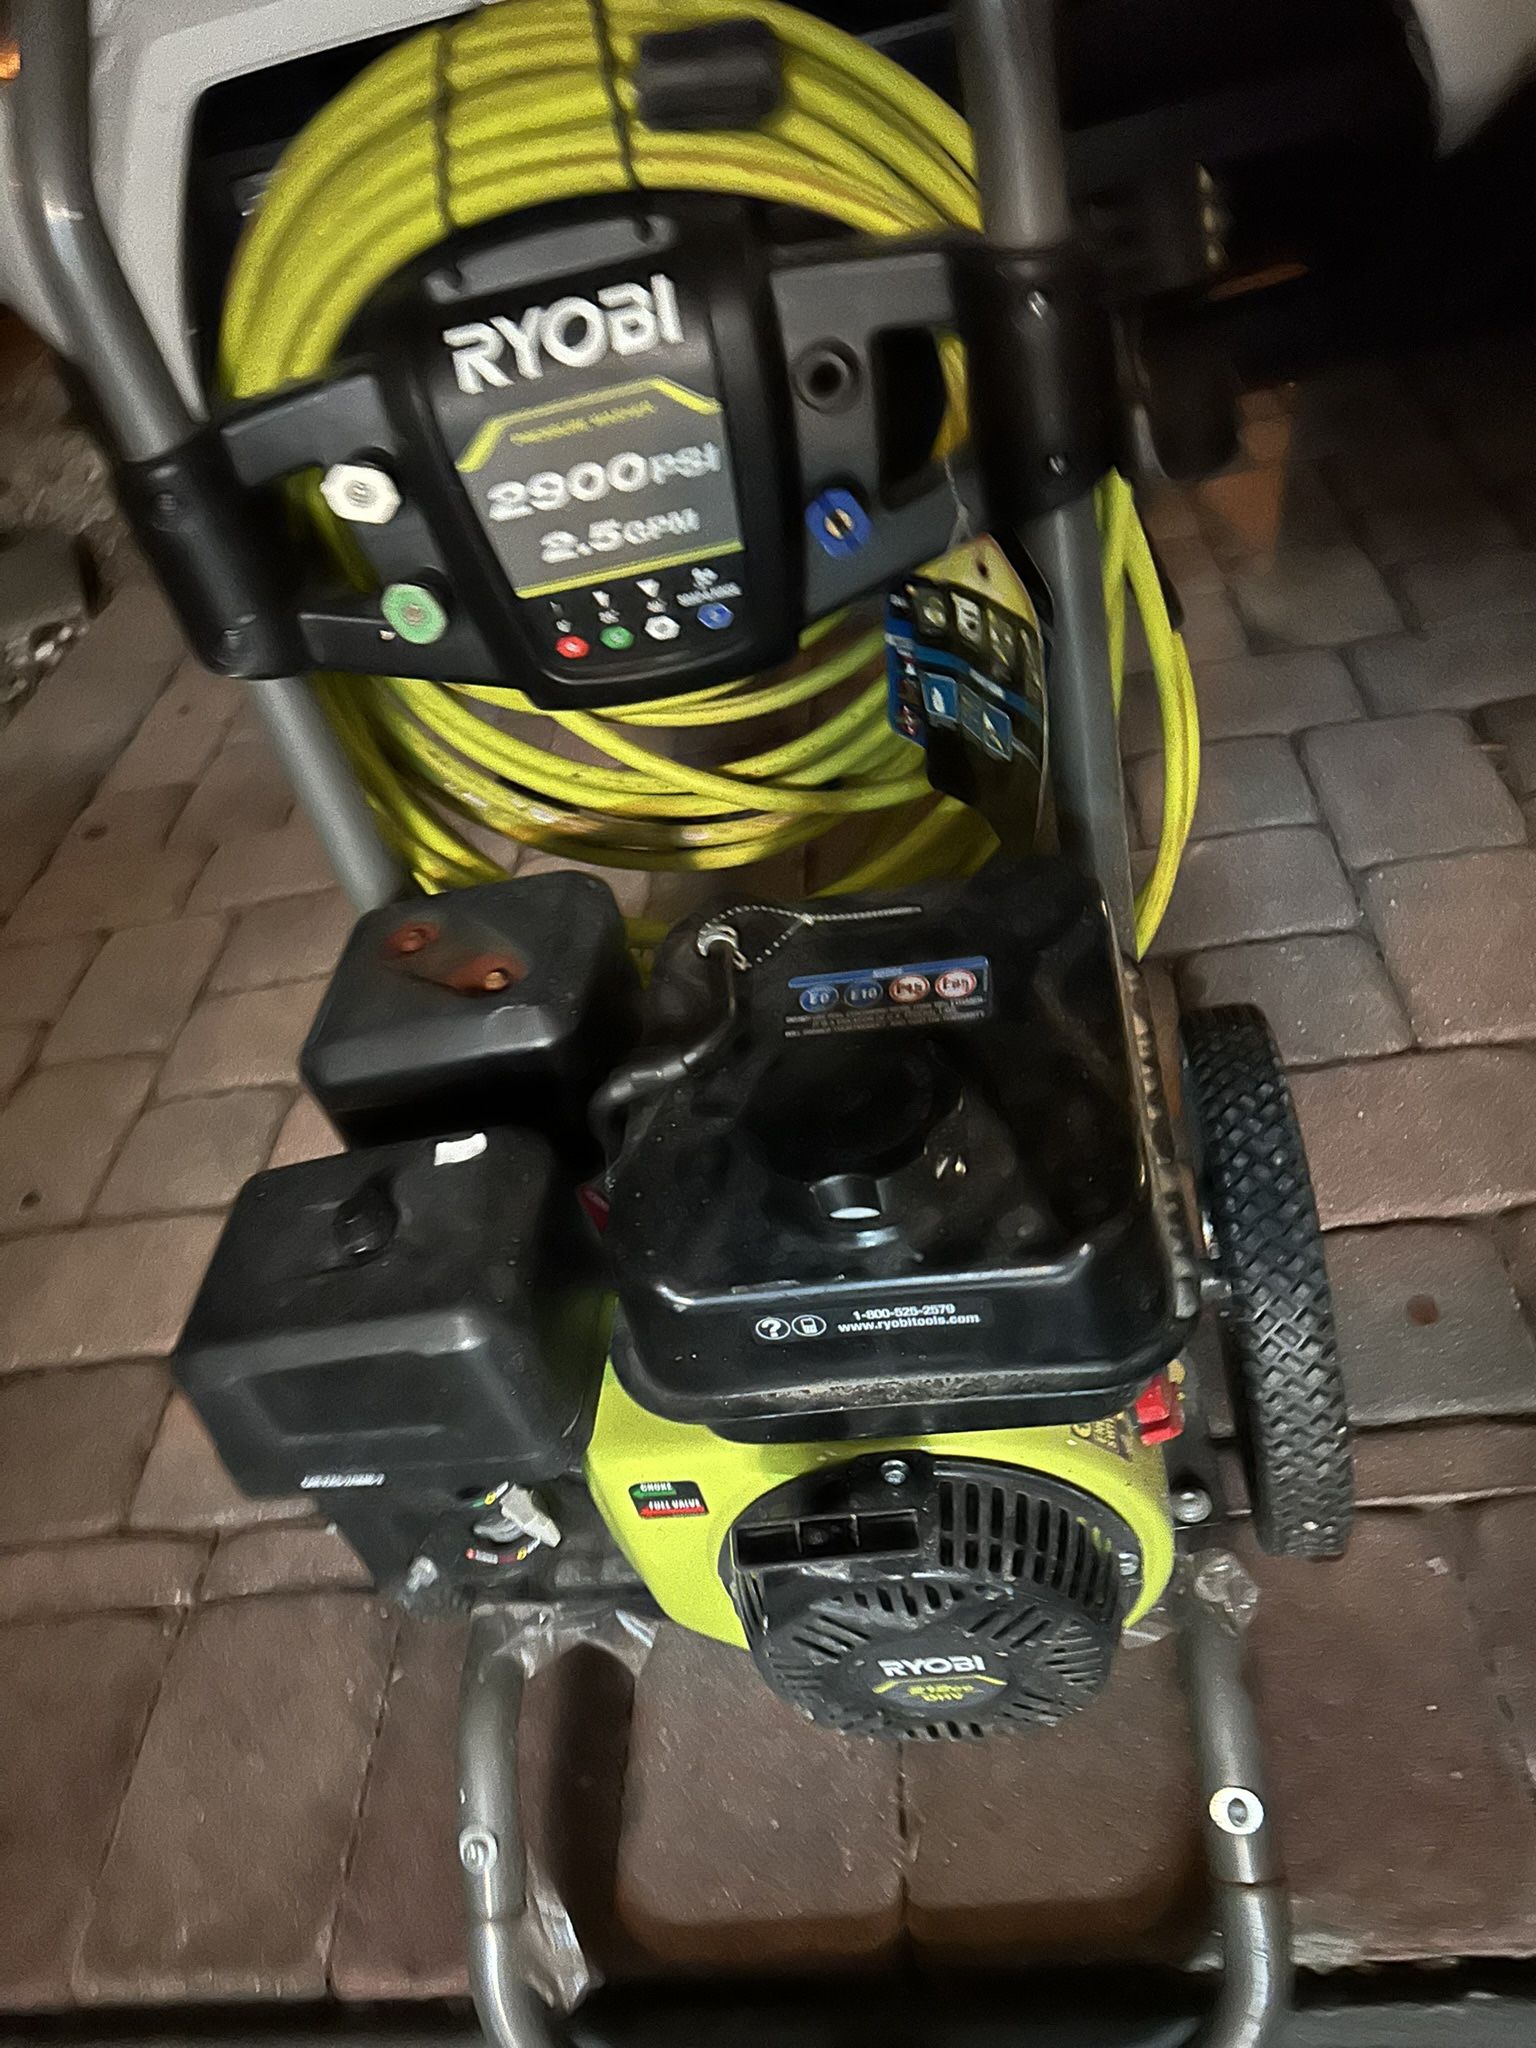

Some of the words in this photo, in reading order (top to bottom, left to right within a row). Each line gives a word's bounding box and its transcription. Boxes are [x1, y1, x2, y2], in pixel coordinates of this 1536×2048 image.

[442, 273, 685, 394] RYOBI
[837, 1313, 980, 1331] www.ryobitools.com
[877, 1654, 986, 1677] RYOBI
